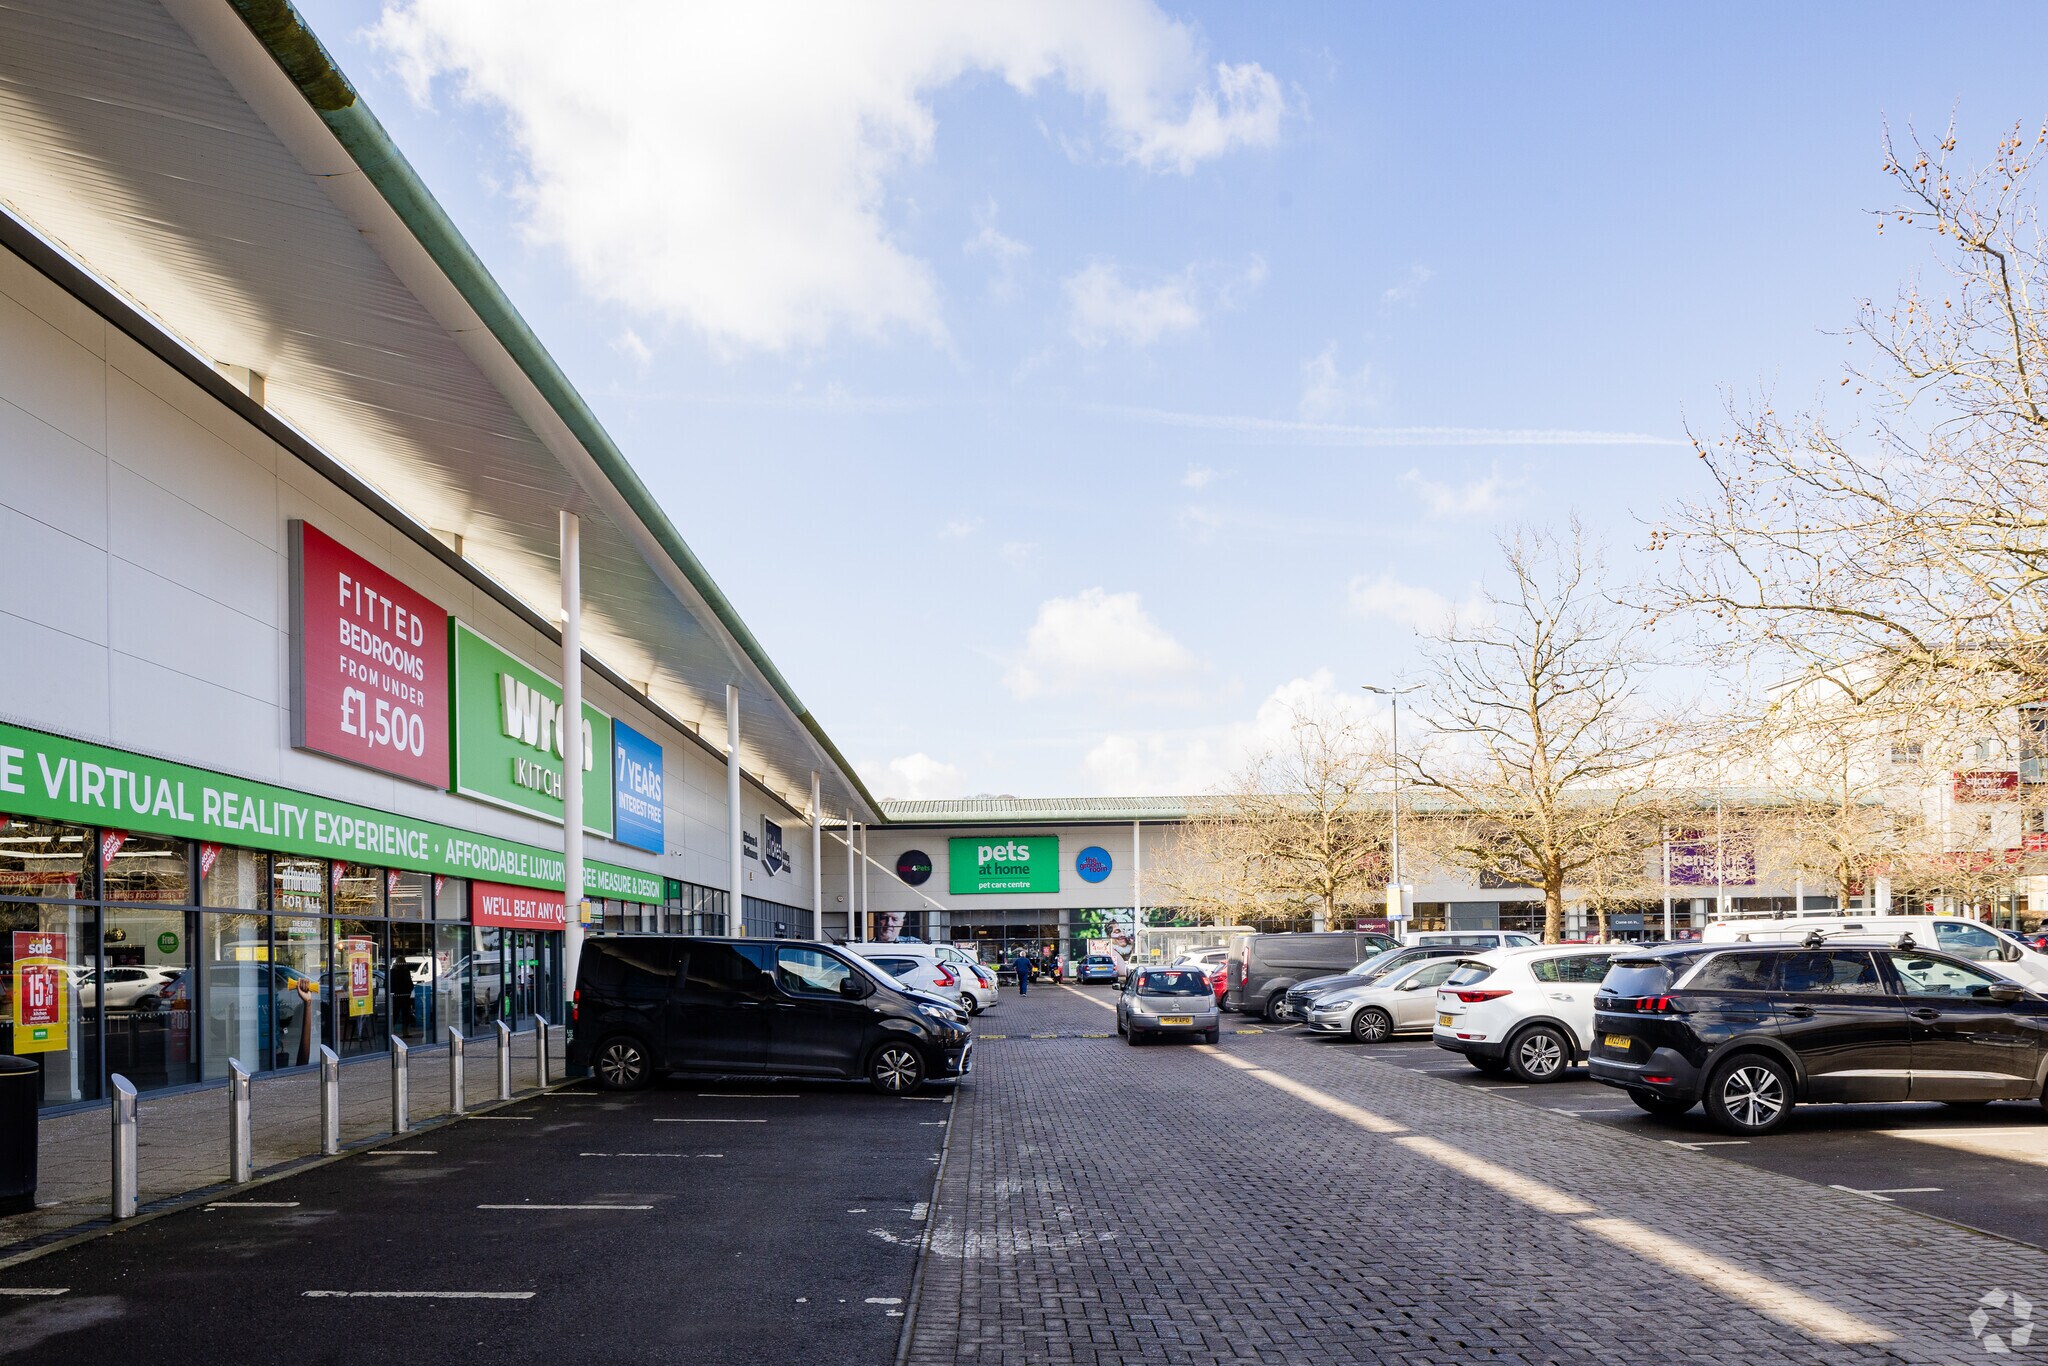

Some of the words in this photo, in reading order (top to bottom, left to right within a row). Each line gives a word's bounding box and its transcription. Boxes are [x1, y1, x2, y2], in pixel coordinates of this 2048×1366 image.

[339, 571, 424, 647] FITTED
[339, 617, 424, 681] BEDROOMS
[340, 655, 378, 687] FROM
[382, 674, 424, 708] UNDER
[340, 686, 425, 757] £1,500
[499, 673, 593, 772] wrn
[618, 746, 626, 782] 7
[627, 758, 661, 801] YEARS
[618, 791, 647, 817] INTEREST
[648, 804, 662, 823] FREE
[37, 752, 195, 822] VIRTUAL
[203, 787, 308, 840] REALITY
[314, 810, 429, 860] EXPERIENCE
[445, 838, 528, 877] AFFORDABLE
[530, 855, 565, 883] LUXURY
[597, 869, 631, 894] MEASURE
[632, 877, 637, 894] &
[638, 879, 660, 898] DESIGN
[103, 832, 116, 855] NOW
[105, 839, 121, 862] OPEN
[978, 841, 1031, 866] pets
[203, 851, 216, 872] OPEN
[979, 864, 992, 875] at
[994, 862, 1030, 875] home
[978, 882, 991, 890] pet
[283, 894, 301, 908] FOR
[305, 896, 321, 909] ALL
[482, 896, 512, 917] WE'LL
[514, 899, 537, 918] BEAT
[538, 902, 554, 920] ANY
[1359, 923, 1386, 932] hobbycraft
[28, 938, 53, 954] sale
